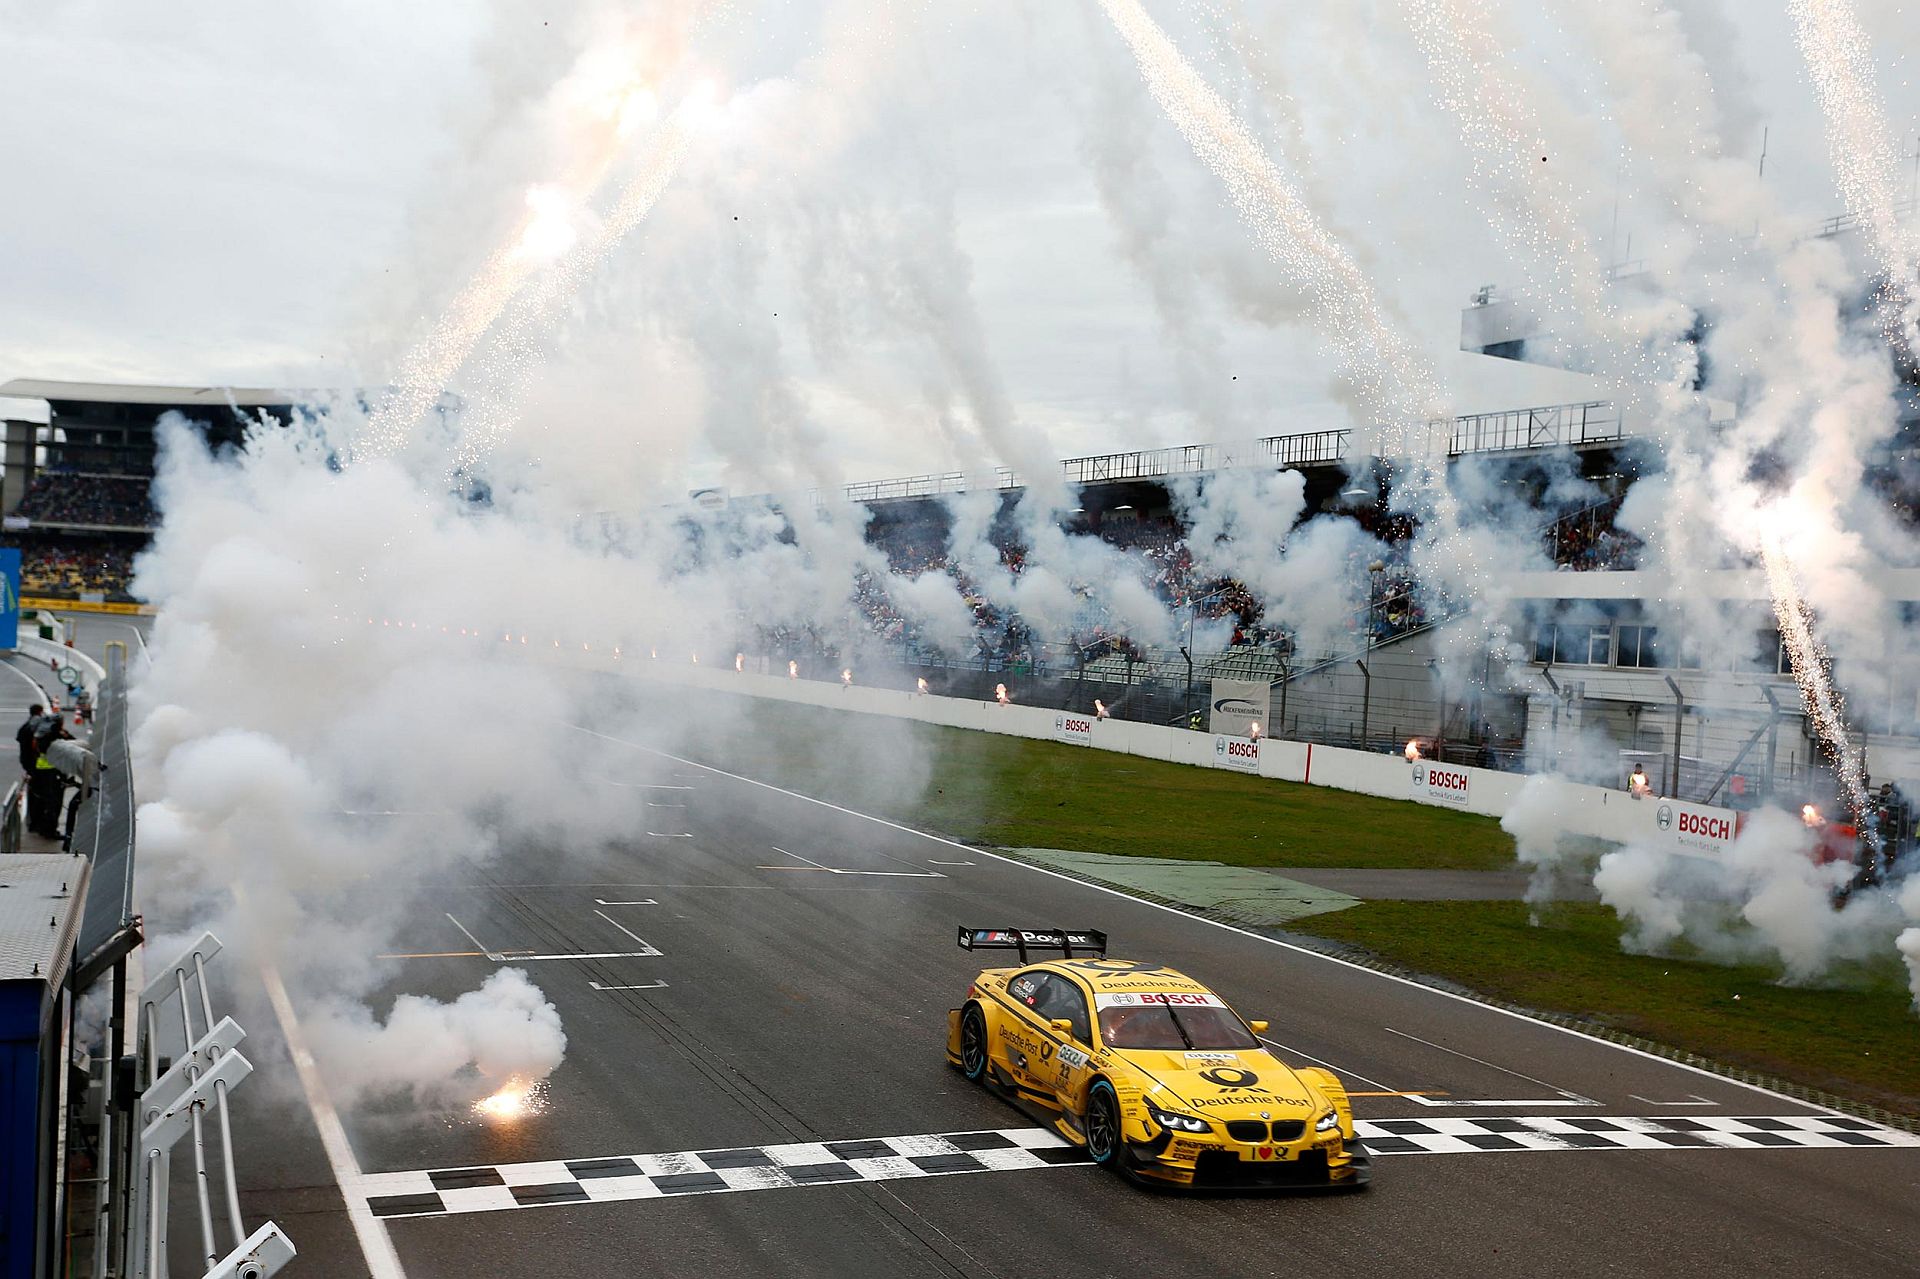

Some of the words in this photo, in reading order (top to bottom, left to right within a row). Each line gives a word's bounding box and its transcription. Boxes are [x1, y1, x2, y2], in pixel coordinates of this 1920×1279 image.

[1065, 719, 1090, 733] BOSCH
[1228, 741, 1258, 758] BOSCH
[1429, 770, 1467, 790] BOSCH
[1679, 812, 1729, 840] BOSCH
[1101, 980, 1168, 989] Deutsche
[1170, 981, 1202, 990] Post
[1140, 994, 1209, 1005] BOSCH
[1000, 1024, 1024, 1048] Deutsche
[1024, 1038, 1038, 1056] Post
[1060, 1046, 1083, 1067] DEKRA
[1191, 1095, 1265, 1108] Deutsche
[1274, 1096, 1313, 1109] Post
